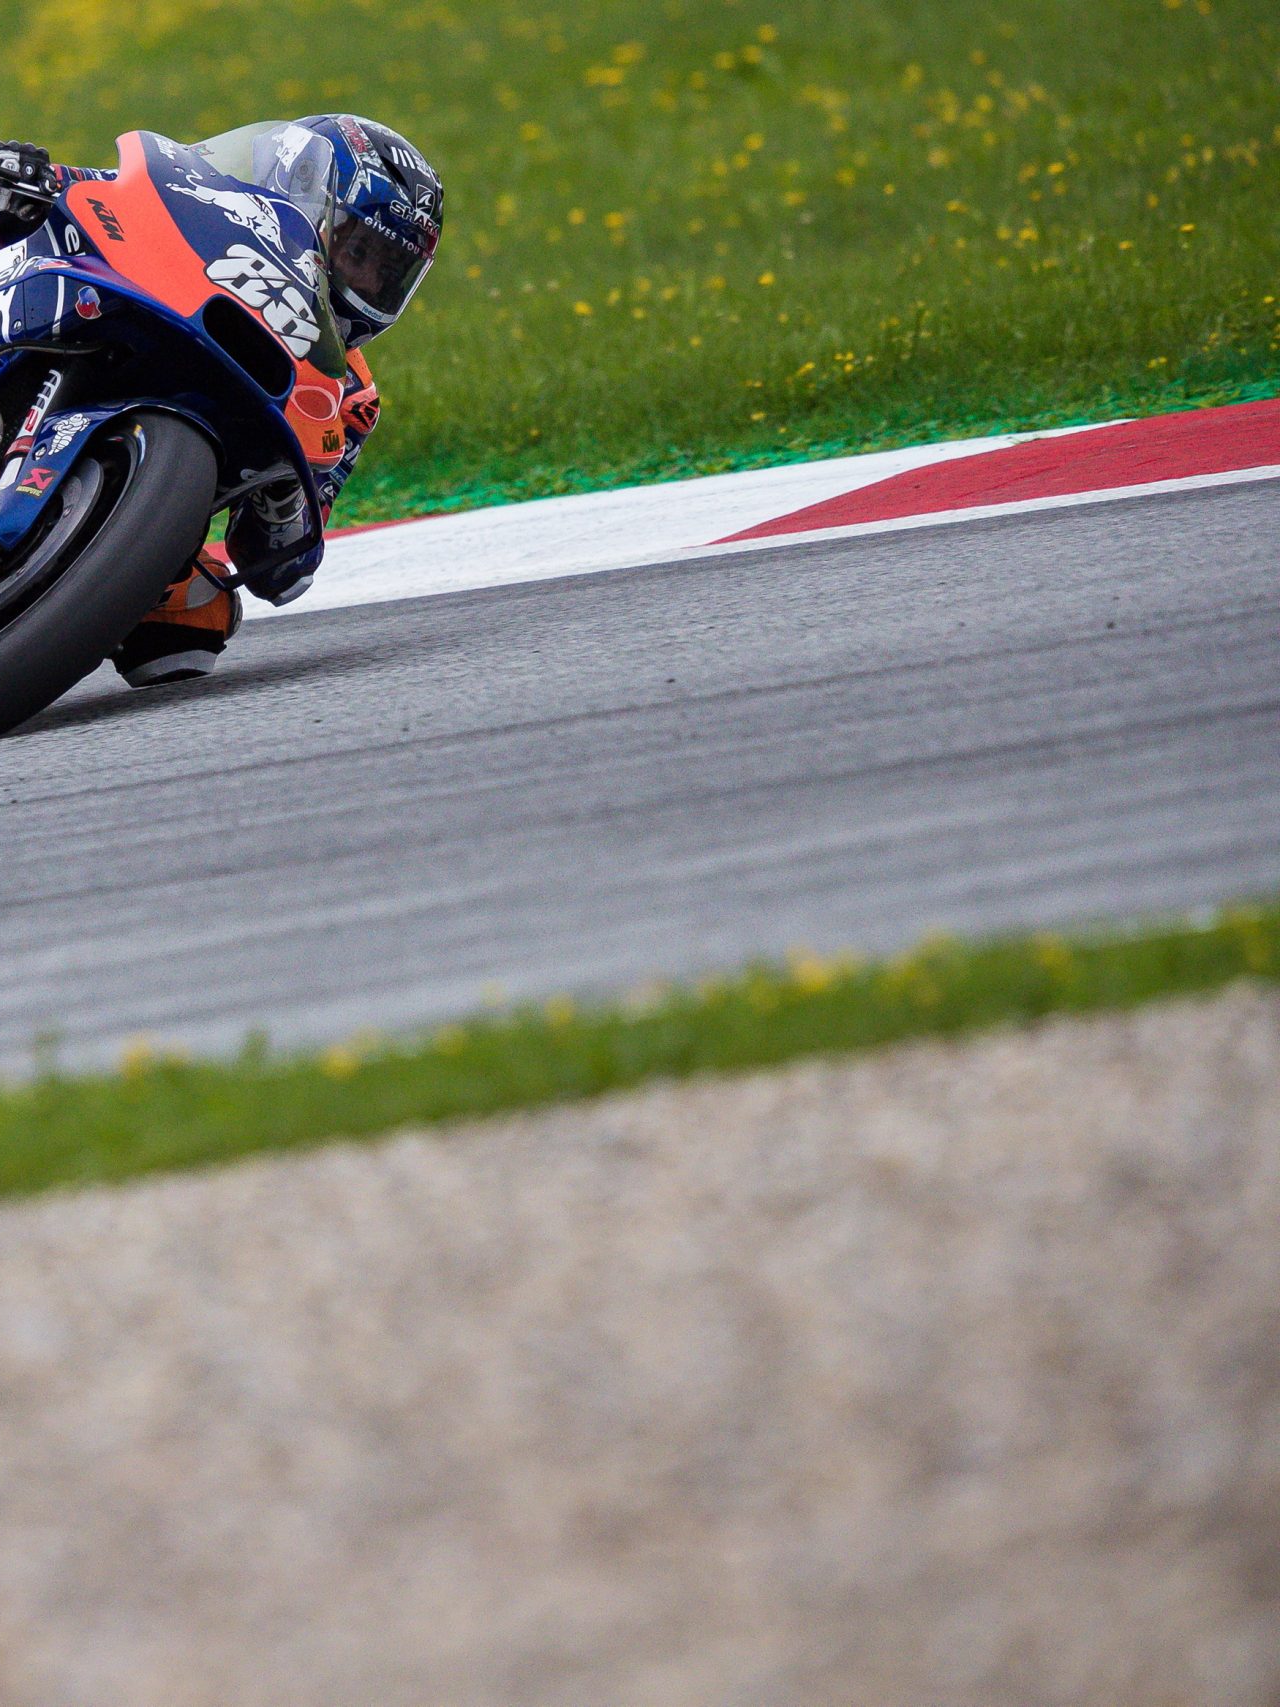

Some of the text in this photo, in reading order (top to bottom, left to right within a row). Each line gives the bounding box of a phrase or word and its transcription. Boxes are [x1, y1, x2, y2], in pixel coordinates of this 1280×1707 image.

[86, 198, 125, 242] KTM
[364, 216, 397, 240] GIVES
[401, 237, 420, 255] YOU
[204, 243, 322, 359] 88
[322, 430, 341, 453] KTM
